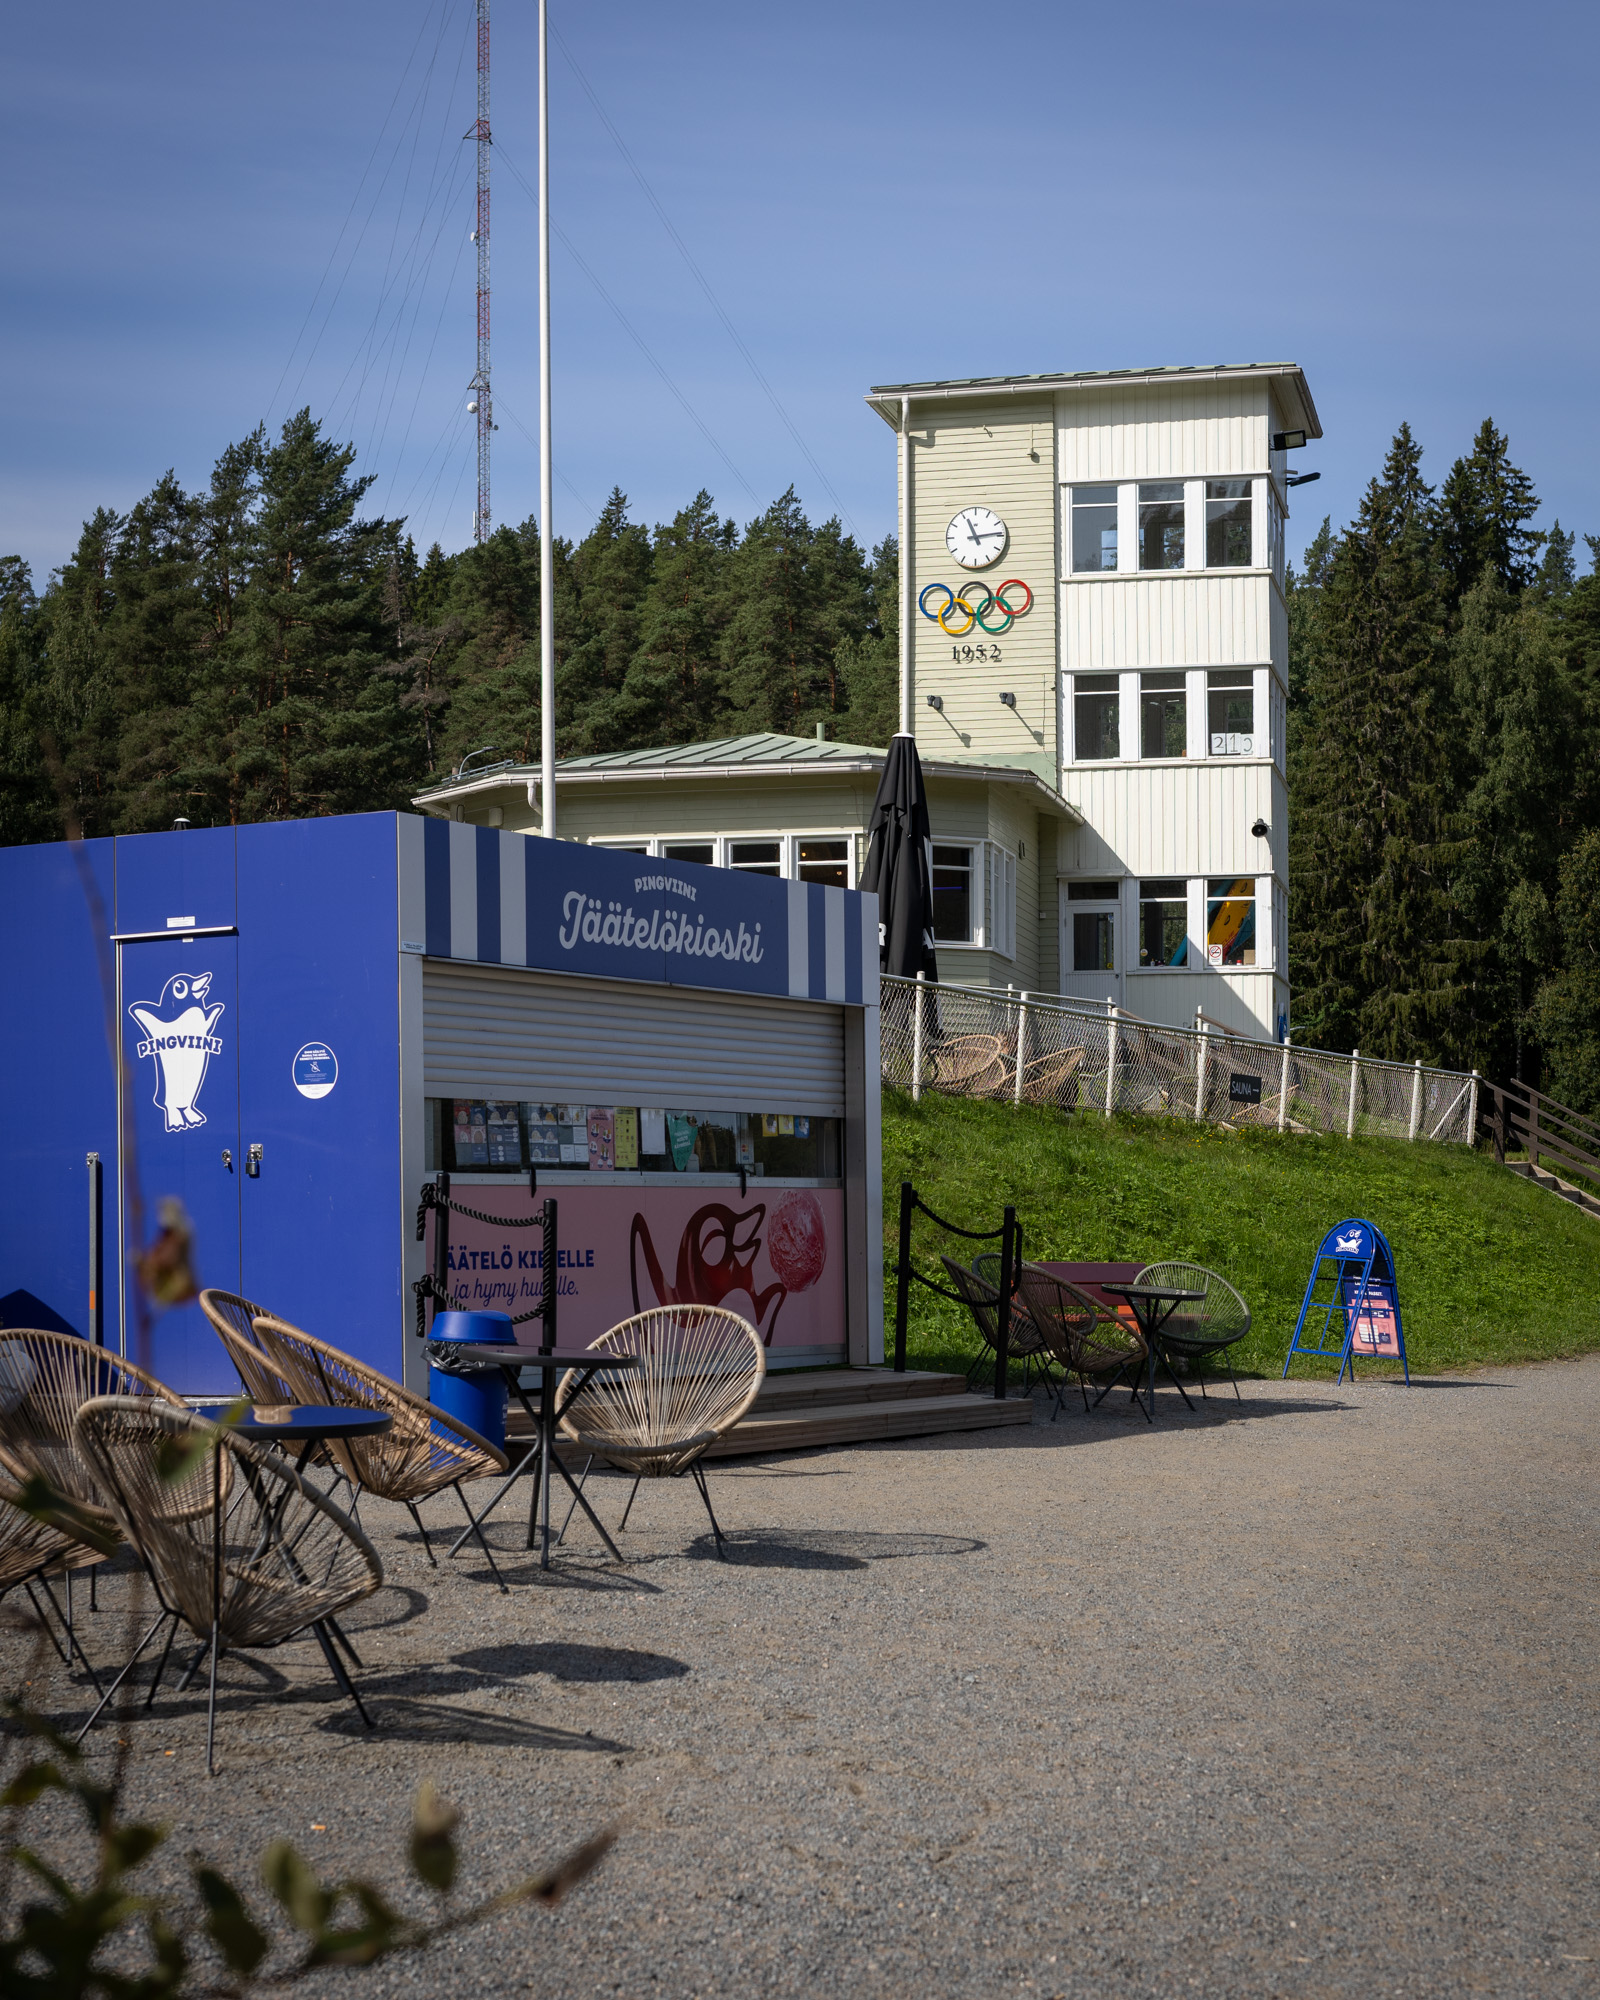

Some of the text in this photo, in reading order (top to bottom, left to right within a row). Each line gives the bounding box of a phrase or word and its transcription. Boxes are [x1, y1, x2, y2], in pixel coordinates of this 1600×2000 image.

[951, 644, 999, 661] 1952
[634, 875, 697, 902] PINGVIINI
[559, 890, 764, 964] Jäätelökioski
[138, 1035, 221, 1057] PINGVIINI
[1231, 1080, 1252, 1096] SAUNA
[441, 1245, 595, 1270] ÄÄTELÖ KIEELLE
[450, 1278, 471, 1308] ja
[473, 1277, 518, 1307] hymy
